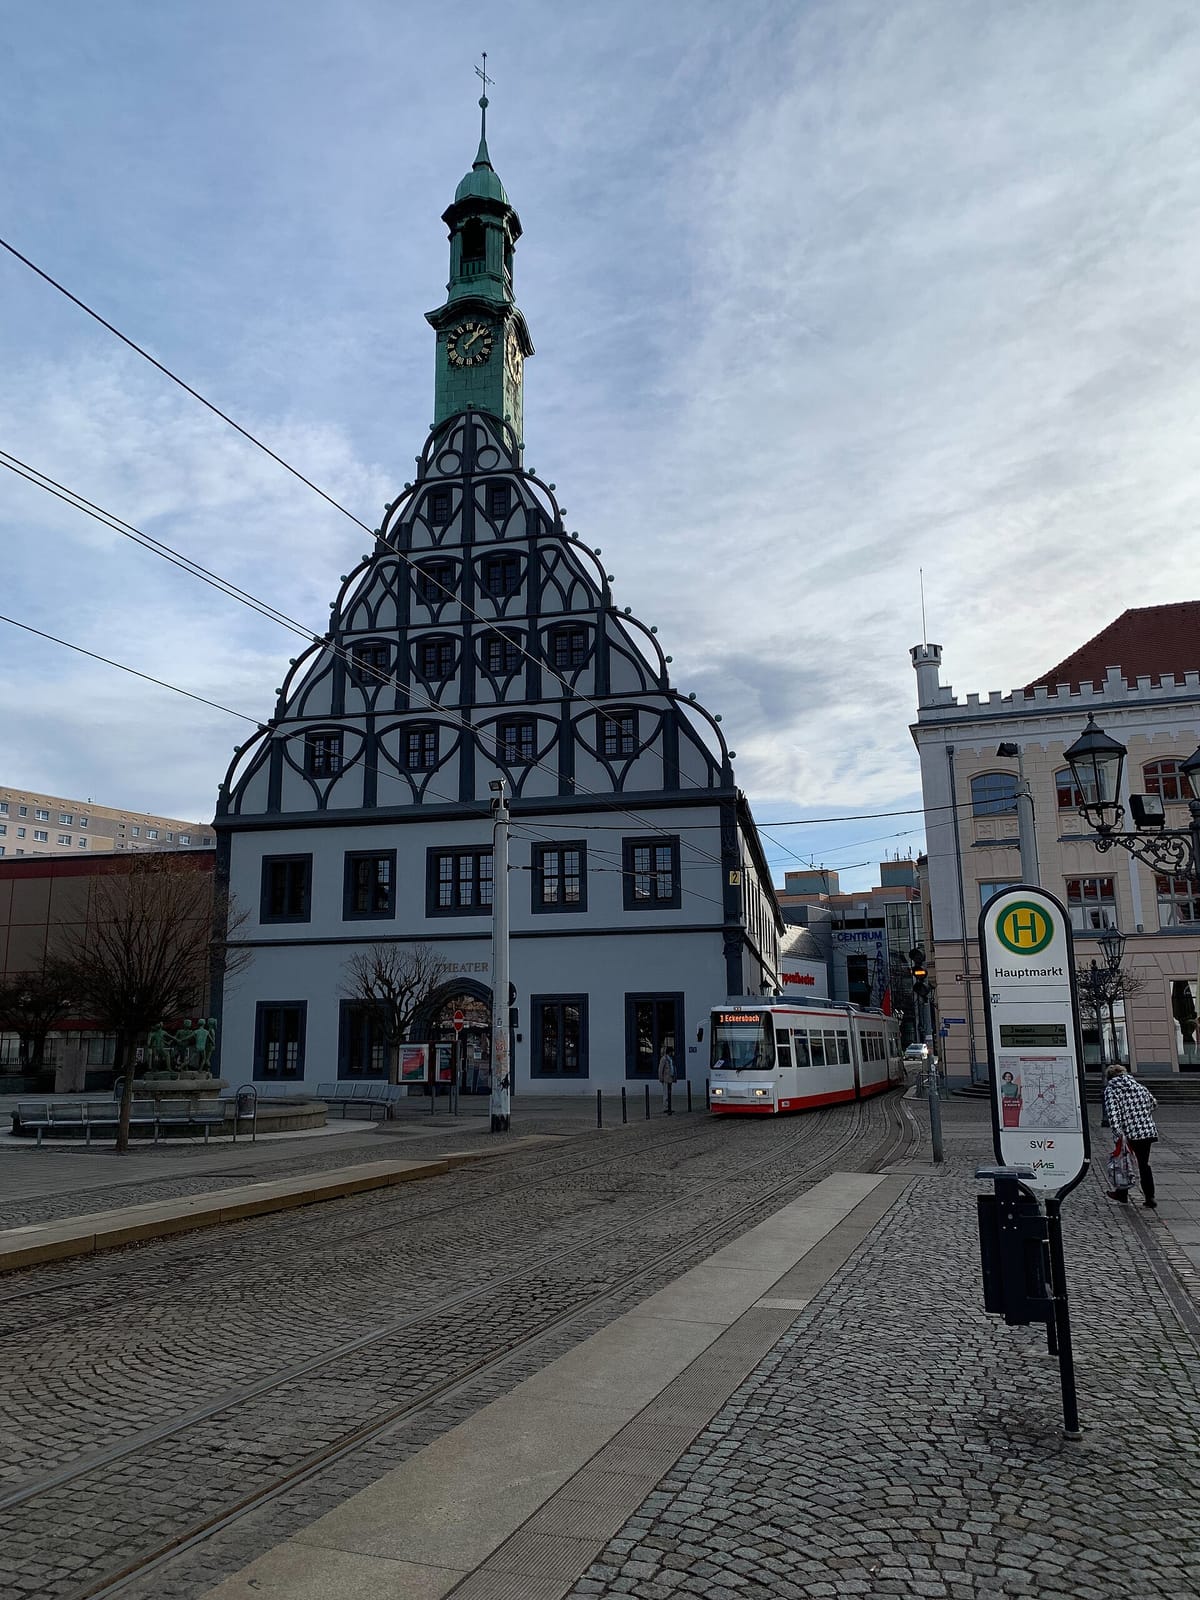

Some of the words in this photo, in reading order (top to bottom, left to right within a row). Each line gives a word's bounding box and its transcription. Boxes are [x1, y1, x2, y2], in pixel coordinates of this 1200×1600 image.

[1012, 912, 1038, 944] H
[837, 931, 882, 942] CENTRUM
[994, 966, 1064, 979] Hauptmarkt
[725, 1014, 760, 1023] Eckersbach
